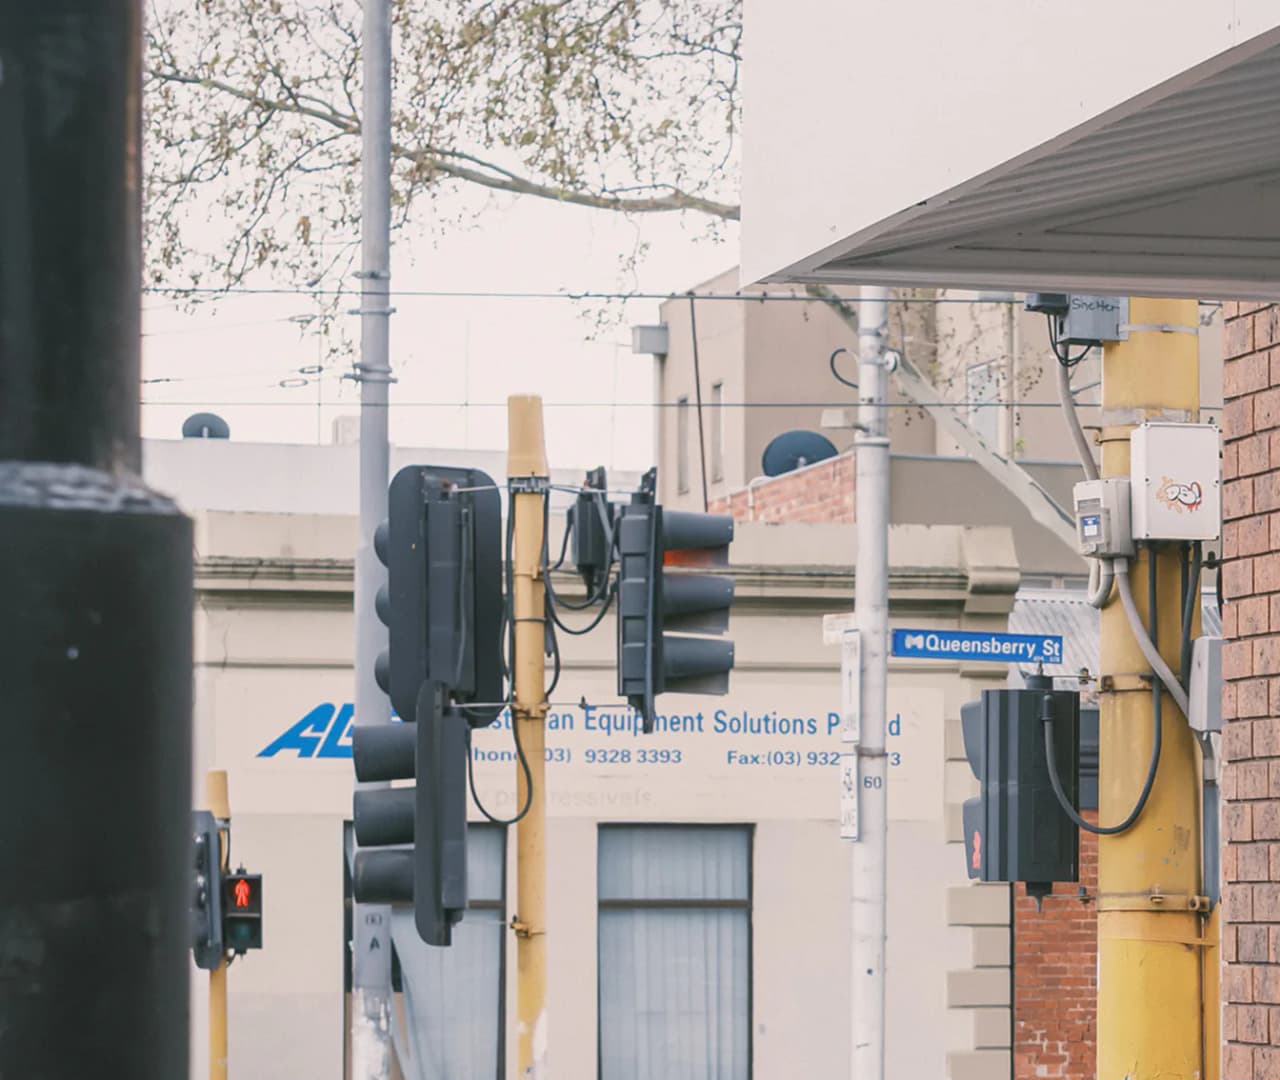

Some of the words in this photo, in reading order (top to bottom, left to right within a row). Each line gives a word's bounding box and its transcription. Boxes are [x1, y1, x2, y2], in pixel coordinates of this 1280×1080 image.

[925, 633, 1036, 659] Queensberry
[1042, 639, 1060, 657] St
[584, 706, 704, 737] Equipment
[713, 709, 818, 736] Solutions
[474, 747, 518, 763] hon
[585, 748, 632, 764] 9328
[636, 748, 682, 764] 3393
[807, 751, 841, 767] 932
[863, 775, 882, 790] 60
